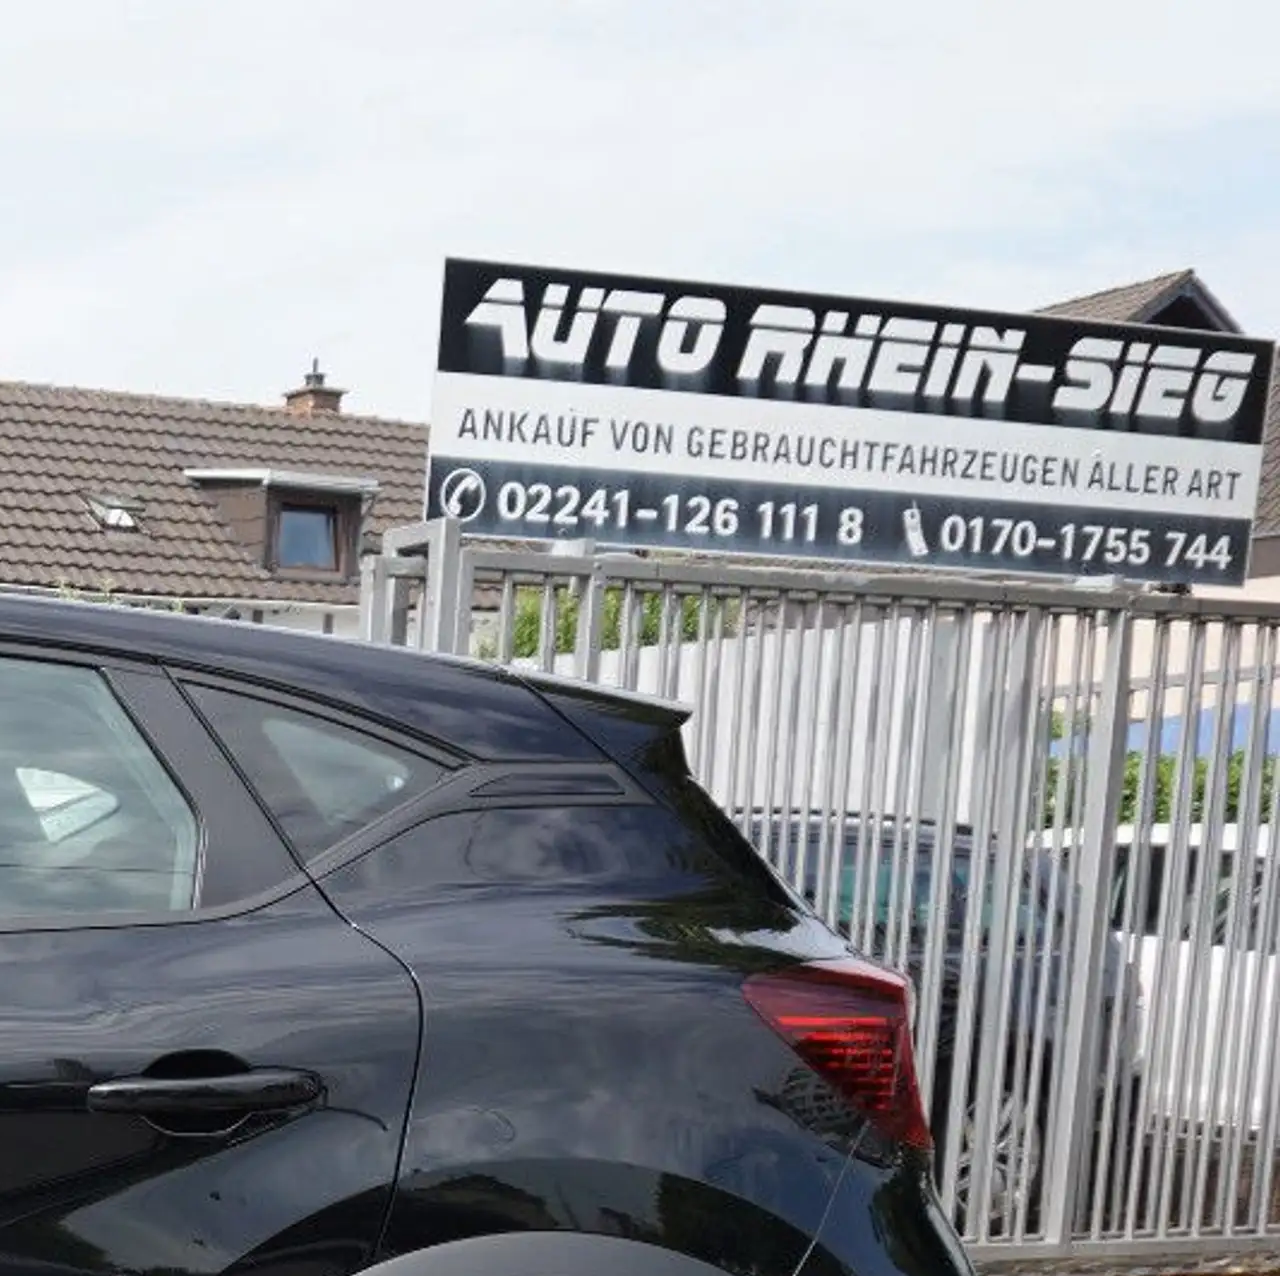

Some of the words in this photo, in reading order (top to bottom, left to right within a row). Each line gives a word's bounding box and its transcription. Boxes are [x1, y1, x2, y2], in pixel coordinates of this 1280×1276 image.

[464, 277, 728, 375] AUTO
[736, 304, 1256, 423] RHEIN-SIEG
[457, 406, 600, 448] ANKAUF
[610, 418, 675, 455] VON
[686, 426, 1080, 489] GEBRAUCHTFAHRZEUGEN
[1087, 460, 1179, 496] ALLER
[1187, 468, 1242, 501] ART
[496, 480, 740, 537] 02241-126
[757, 500, 819, 542] 111
[837, 506, 864, 546] 8
[940, 515, 1151, 567] 0170-1755
[1164, 531, 1233, 570] 744
